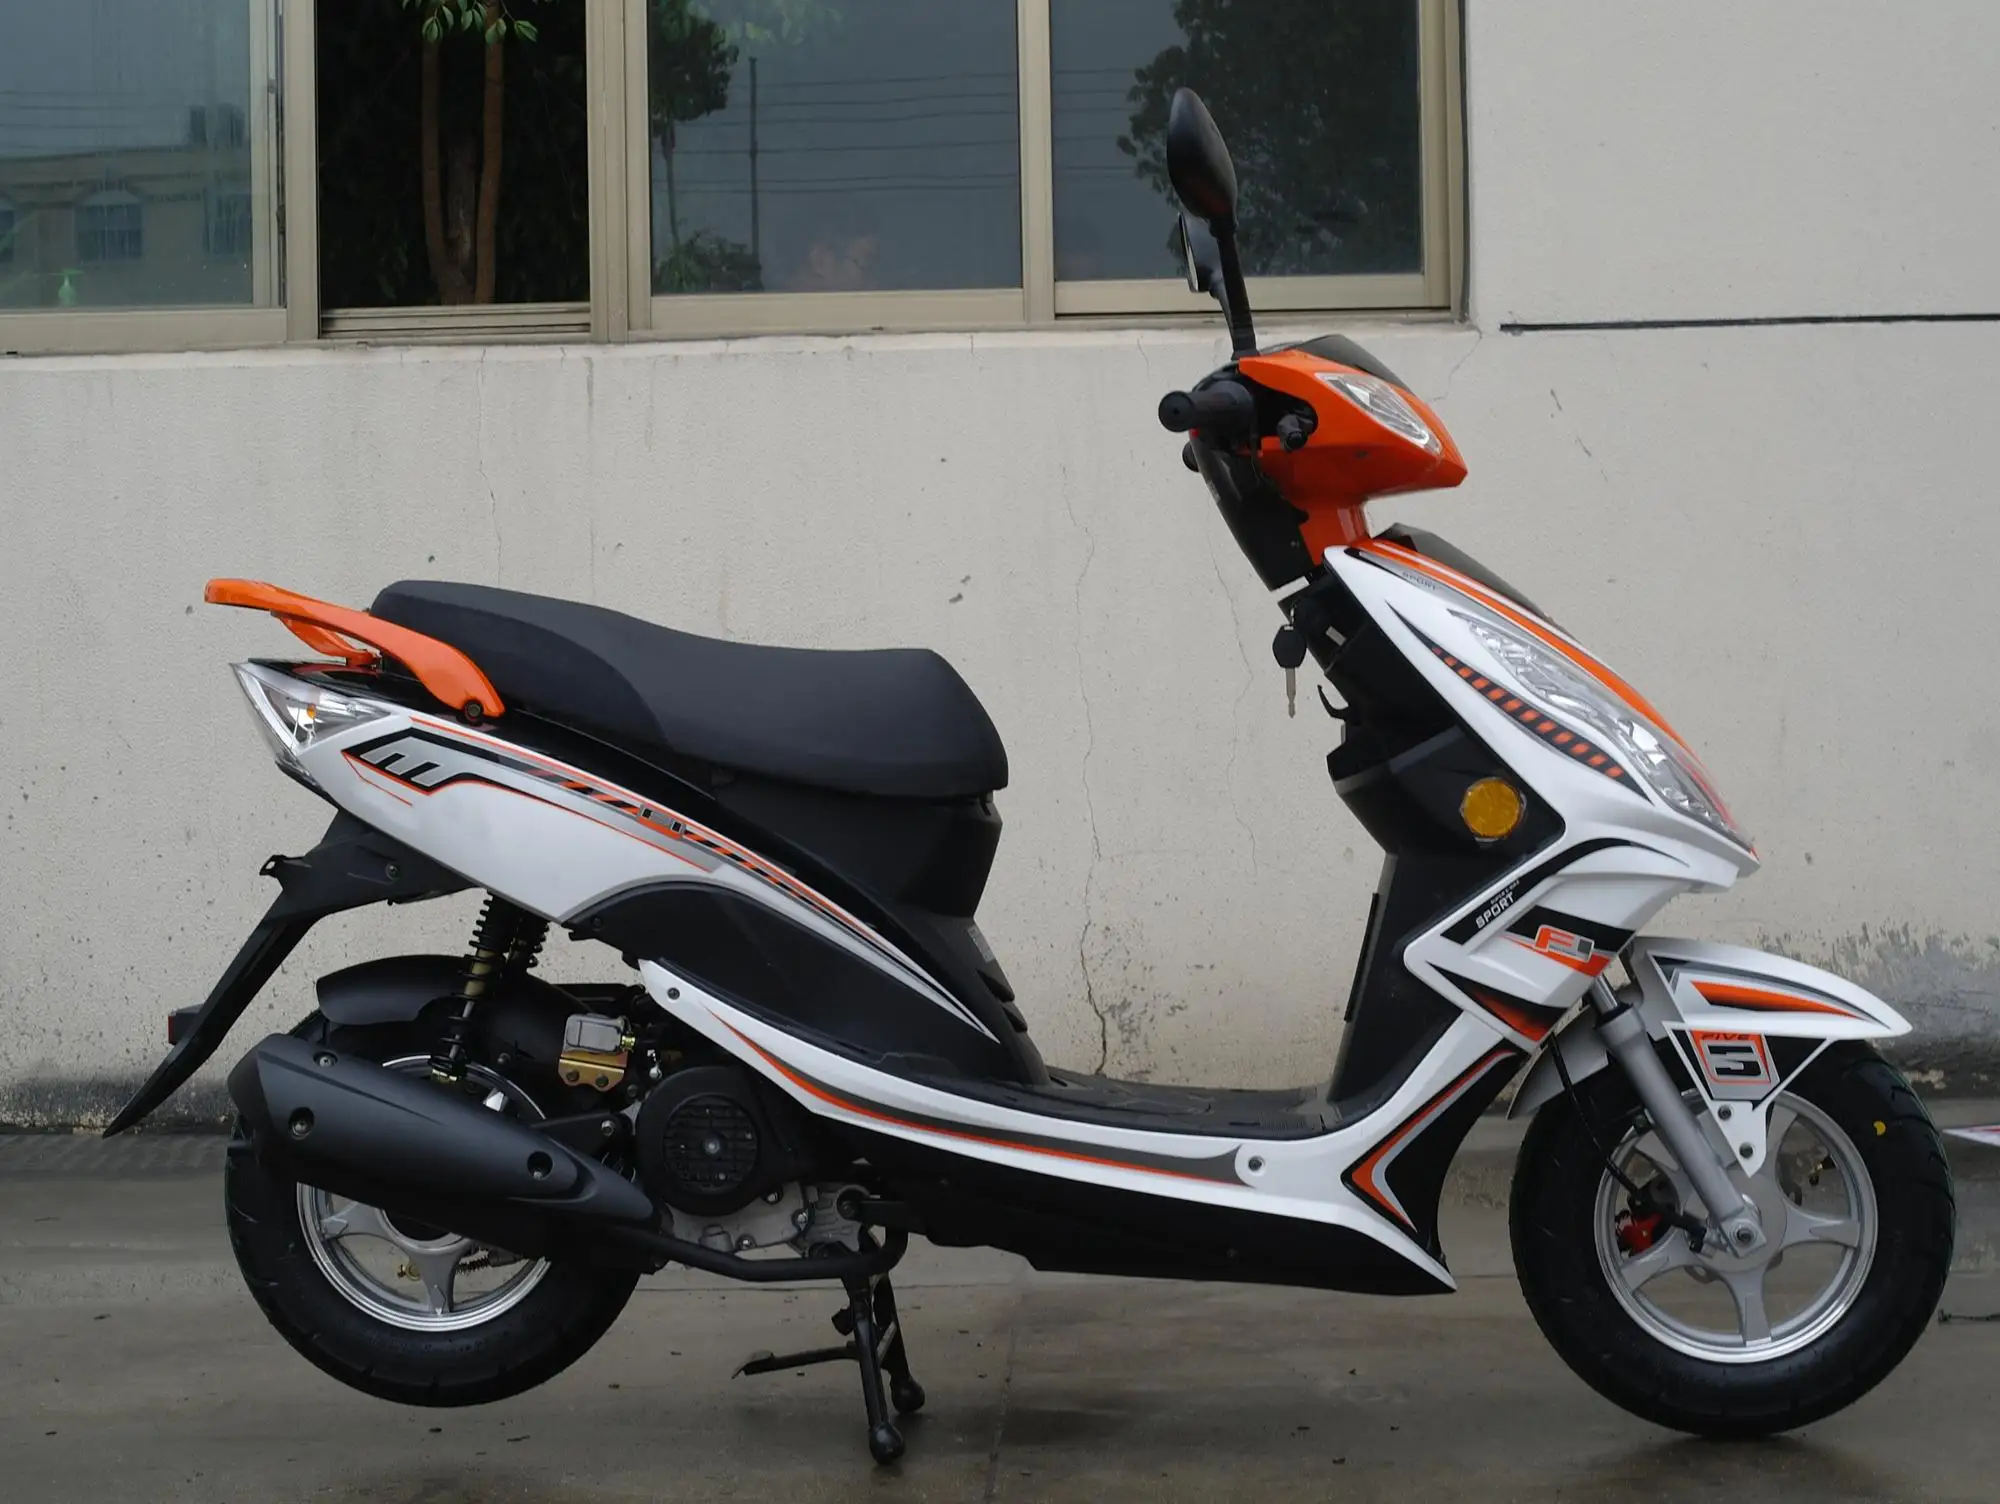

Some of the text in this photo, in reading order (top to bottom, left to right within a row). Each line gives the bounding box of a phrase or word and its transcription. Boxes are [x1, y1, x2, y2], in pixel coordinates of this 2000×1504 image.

[1475, 891, 1514, 929] SPORT
[1701, 1032, 1750, 1041] FIVE
[1707, 1046, 1762, 1077] 5
